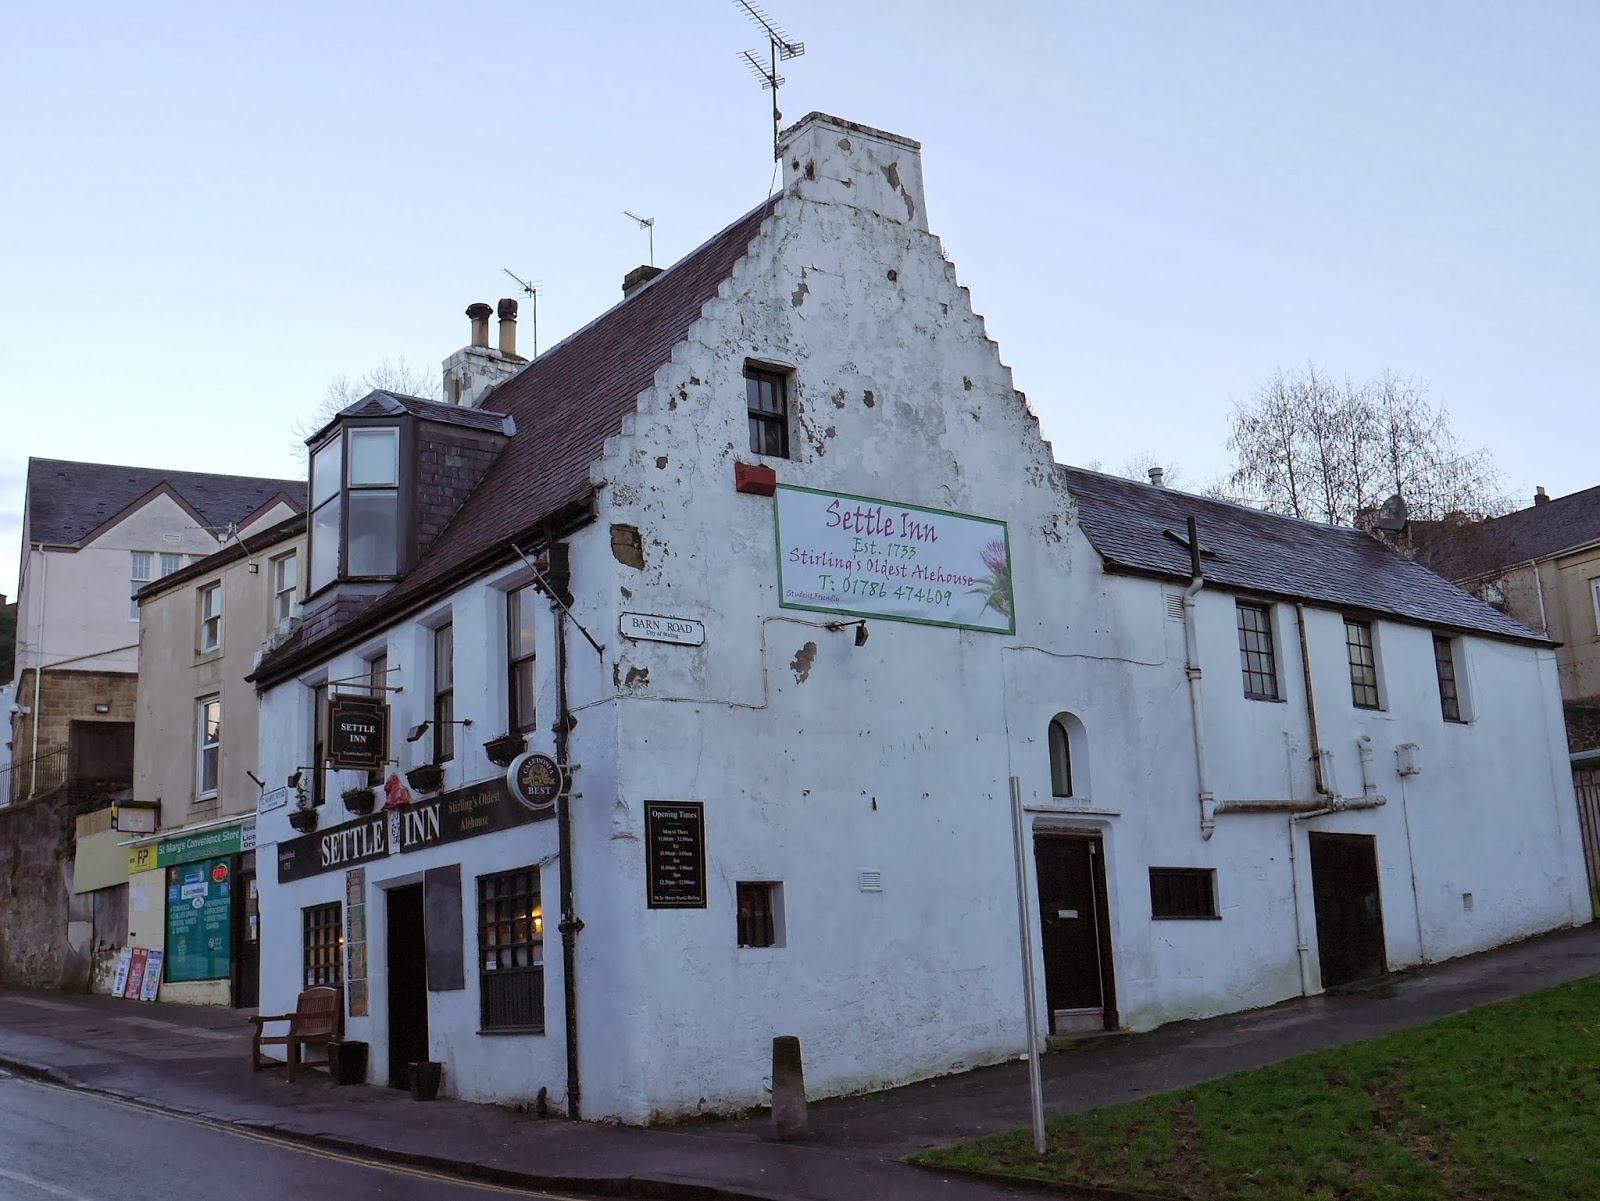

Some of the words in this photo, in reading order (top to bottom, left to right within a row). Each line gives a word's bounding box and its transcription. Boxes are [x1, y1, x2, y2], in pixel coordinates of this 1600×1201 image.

[826, 499, 895, 537] Settle
[899, 512, 938, 543] Inn
[853, 536, 881, 555] Est.
[887, 543, 917, 560] 1733
[789, 547, 861, 577] Stirling's
[866, 559, 907, 579] Oldest
[911, 566, 974, 587] Alehouse
[814, 592, 840, 605] Friendly
[819, 574, 836, 592] T:
[842, 578, 887, 598] 01786
[893, 586, 953, 607] 474609
[632, 617, 660, 630] BARN
[667, 621, 693, 634] ROAD
[646, 629, 656, 637] City
[340, 722, 376, 734] SETTLE
[349, 734, 367, 743] INN
[528, 786, 551, 795] BEST
[448, 795, 478, 814] Stirling's
[478, 791, 500, 806] Oldest
[652, 810, 678, 819] Opening
[679, 811, 698, 819] Times
[461, 816, 489, 831] Alehouse
[159, 844, 166, 854] St
[166, 840, 186, 854] Mary's
[186, 833, 221, 849] Convenience
[222, 830, 240, 841] Store
[321, 820, 385, 867] SETTLE
[403, 803, 441, 847] INN
